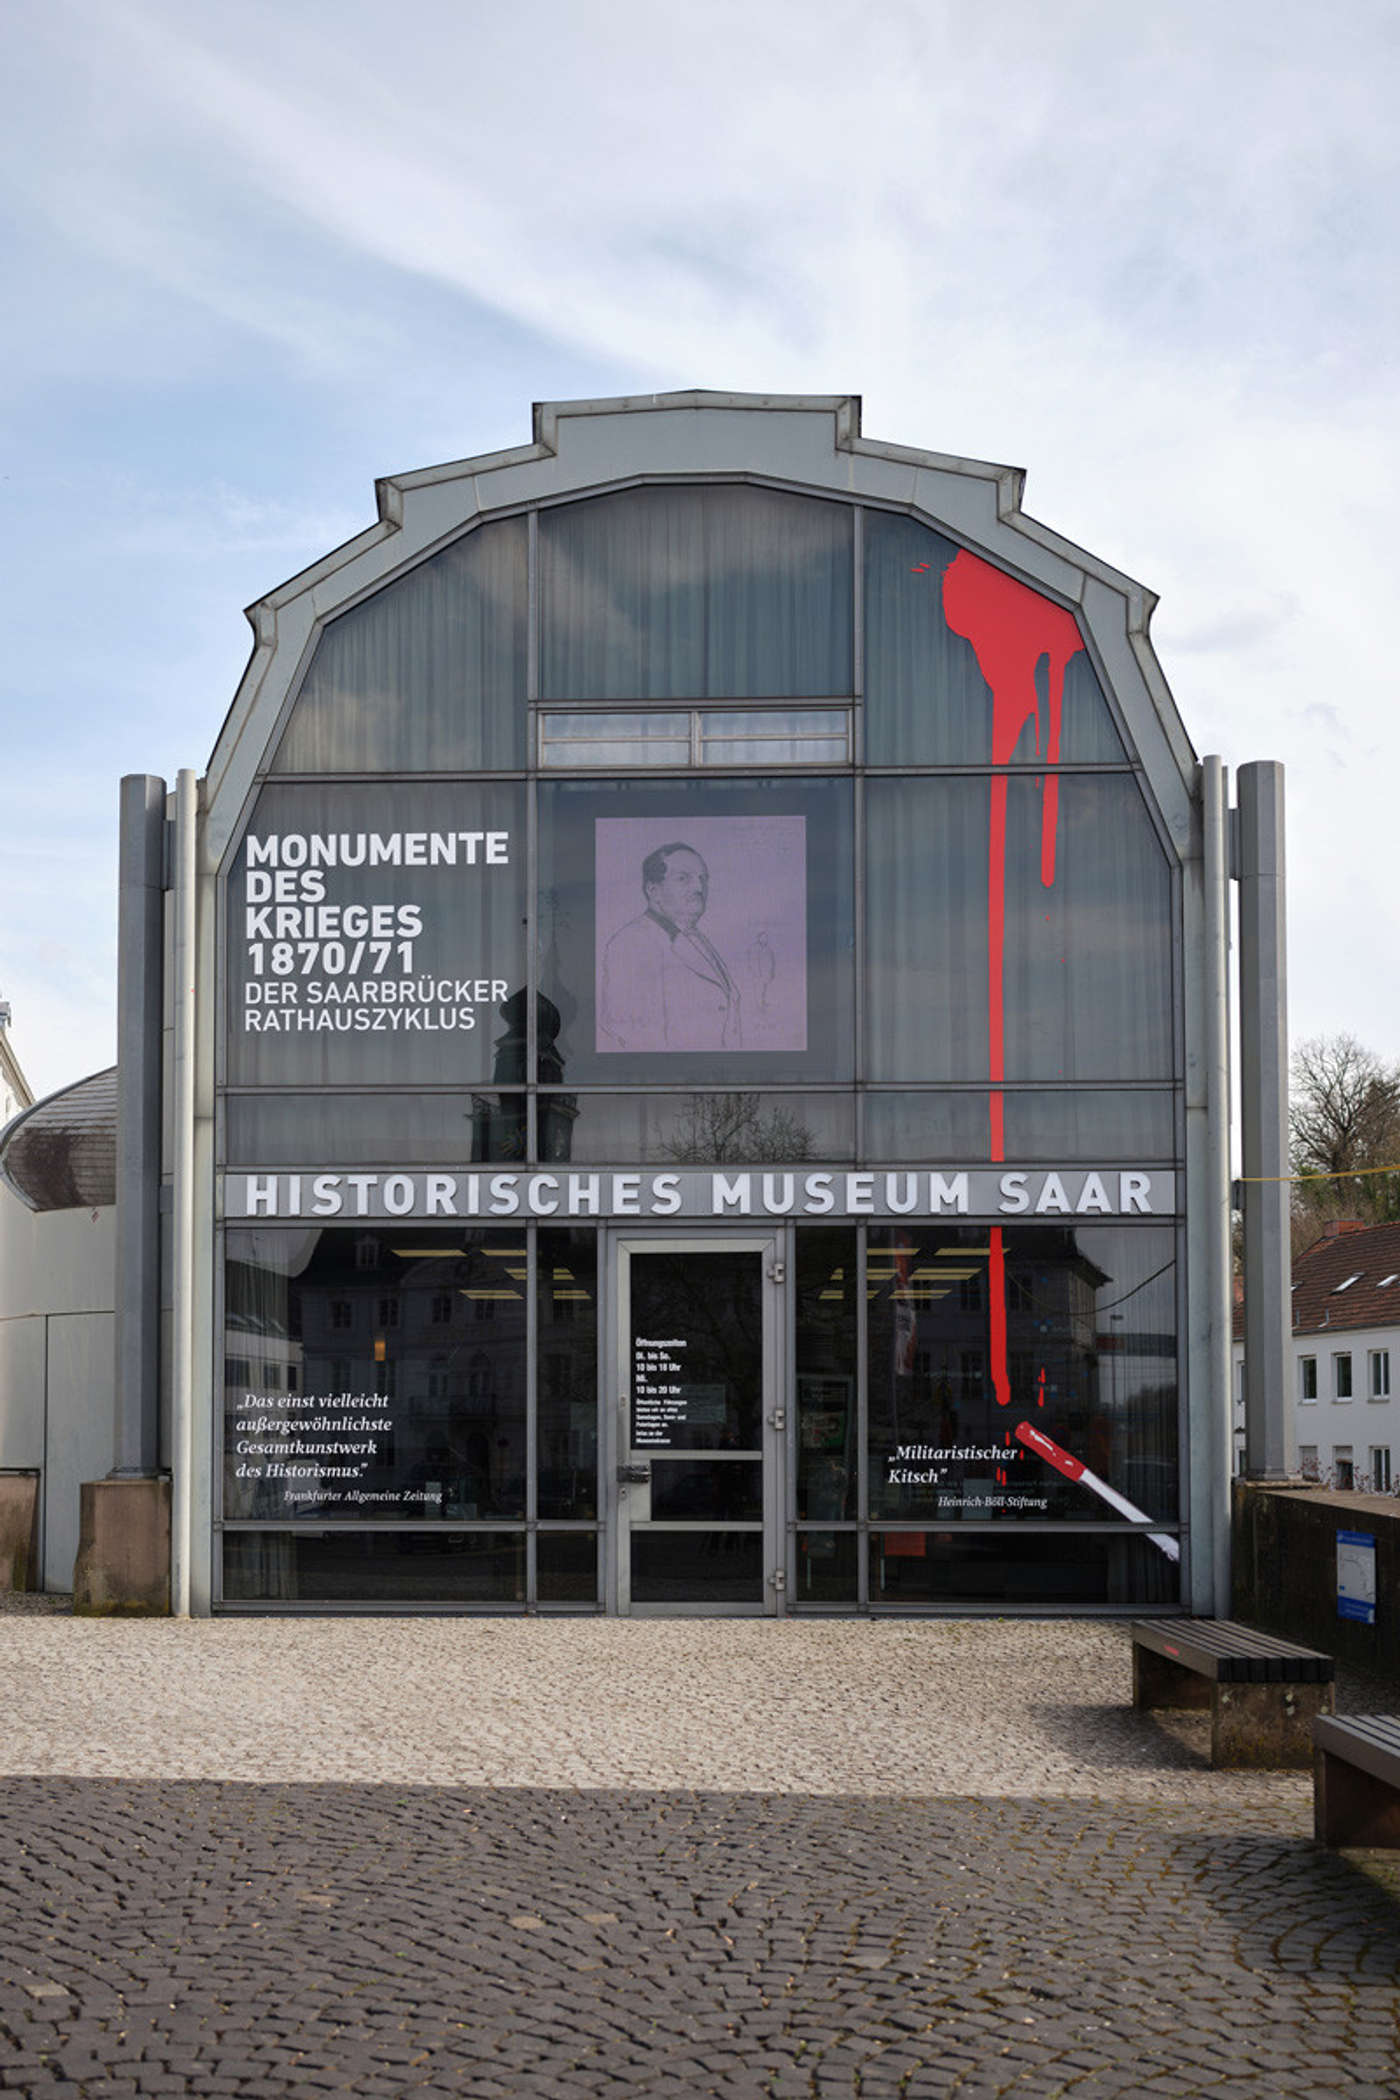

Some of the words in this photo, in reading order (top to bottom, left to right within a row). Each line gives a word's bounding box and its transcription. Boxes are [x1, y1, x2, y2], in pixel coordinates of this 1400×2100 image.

[246, 832, 509, 867] MONUMENTE
[246, 870, 325, 903] DES
[246, 905, 423, 939] KRIEGES
[249, 941, 413, 975] 1870/71
[245, 982, 298, 1004] DER
[306, 975, 508, 1004] SAARBRÜCKER
[245, 1007, 476, 1031] RATHAUSZYKLUS
[246, 1174, 683, 1216] HISTORISCHES
[712, 1172, 970, 1215] MUSEUM
[999, 1171, 1154, 1215] SAAR
[646, 1363, 657, 1371] bis
[669, 1363, 681, 1371] Uhr
[646, 1386, 657, 1394] bis
[669, 1386, 681, 1394] Uhr
[236, 1394, 274, 1410] „Das
[277, 1393, 315, 1409] einst
[318, 1393, 389, 1409] vielleicht
[236, 1416, 392, 1435] außergewöhnlichste
[236, 1440, 377, 1455] Gesamtkunstwerk
[887, 1445, 1018, 1462] „Militaristischer
[236, 1463, 262, 1478] des
[888, 1468, 948, 1484] Kitsch”
[283, 1490, 342, 1504] Frankfurter
[345, 1490, 400, 1505] Allgemeine
[403, 1490, 443, 1504] Zeitung
